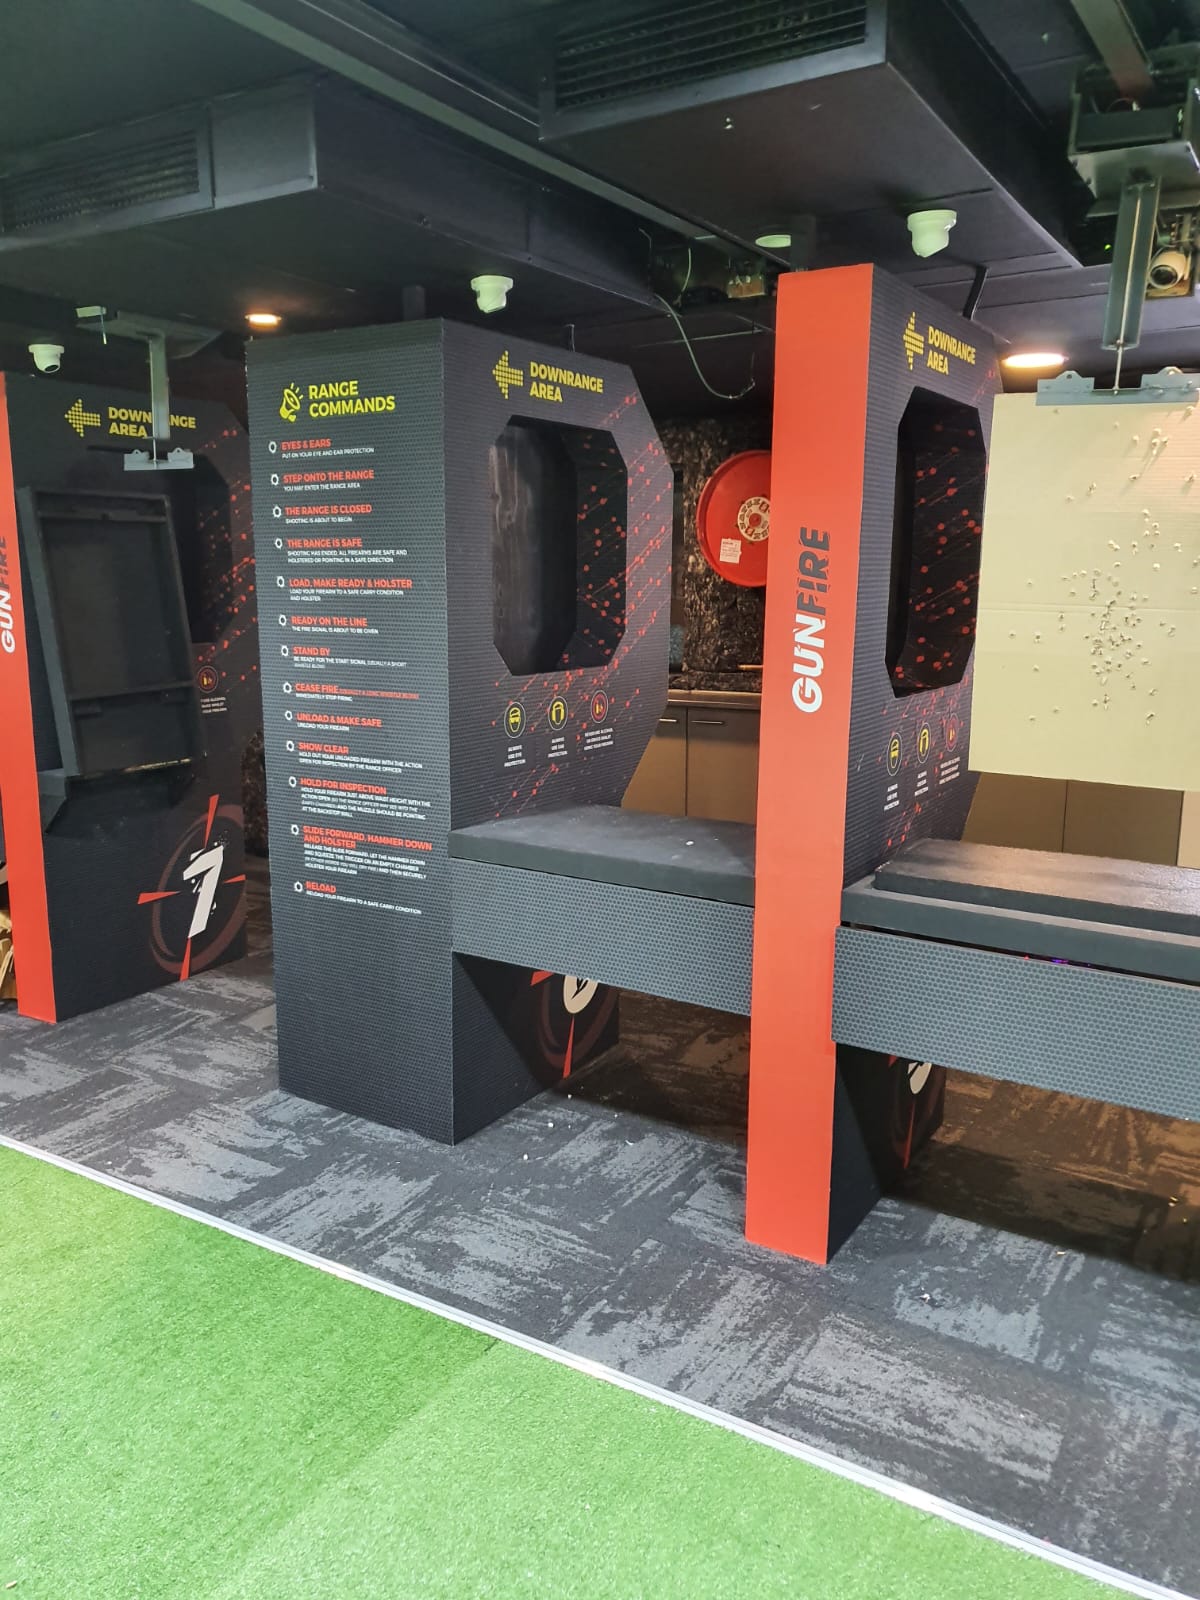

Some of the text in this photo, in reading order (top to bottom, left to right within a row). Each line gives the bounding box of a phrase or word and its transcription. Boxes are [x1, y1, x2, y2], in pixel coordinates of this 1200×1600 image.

[928, 325, 976, 365] DOWNRANGE
[927, 350, 949, 375] AREA
[530, 361, 603, 393] DOWNRANGE
[309, 380, 358, 399] RANGE
[530, 381, 563, 402] AREA
[310, 395, 396, 417] COMMANDS
[108, 406, 196, 428] DOWNNGE
[109, 422, 148, 438] AREA
[281, 438, 331, 450] EYES & EARS
[283, 470, 375, 484] STEP ONTO THE RANGE
[285, 504, 373, 516] THE RANGE IS CLOSED
[288, 538, 363, 548] THE RANGE IS SAFE
[313, 579, 337, 588] MAKE
[338, 579, 366, 588] READY
[367, 579, 374, 588] &
[374, 579, 413, 588] HOLSTER
[291, 616, 368, 627] READY ON THE LINE
[792, 527, 831, 713] GUNFIRE
[293, 646, 330, 656] STAND BY
[295, 683, 321, 694] CEASE
[321, 684, 339, 694] FIRE
[296, 712, 383, 728] UNLOAD & MAKE SAFE
[298, 742, 349, 754] SHOW CLEAR
[300, 778, 387, 795] HOLD FOR INSPECTION
[303, 826, 325, 837] SLIDE
[368, 834, 404, 847] HAMMER
[405, 838, 433, 851] DOWN
[304, 835, 356, 849] AND HOLSTER
[305, 881, 336, 893] RELOAD
